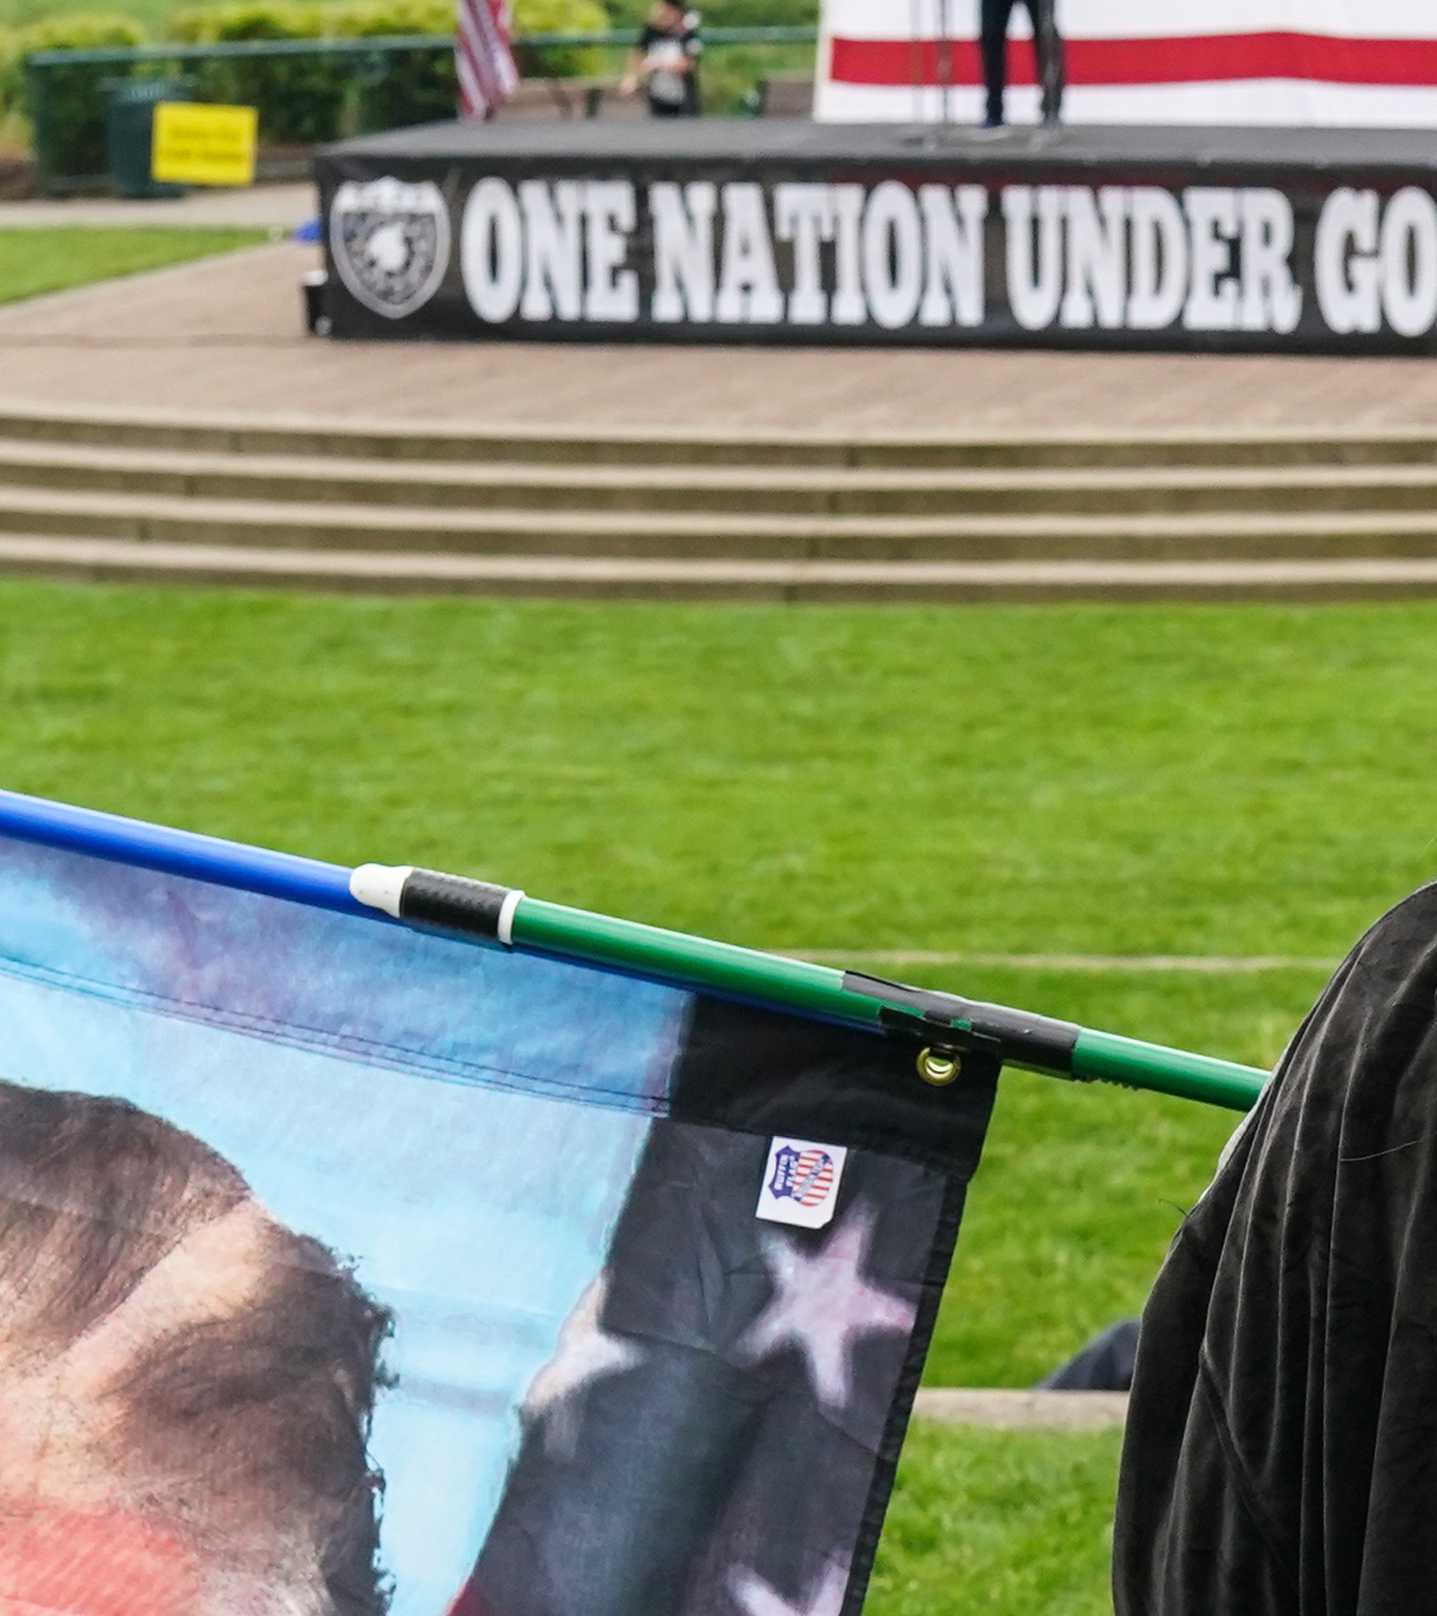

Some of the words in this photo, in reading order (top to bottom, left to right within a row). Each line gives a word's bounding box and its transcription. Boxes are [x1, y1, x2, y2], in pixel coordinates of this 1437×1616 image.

[460, 176, 640, 324] ONE
[650, 180, 988, 330] NATION
[1002, 186, 1303, 334] UNDER
